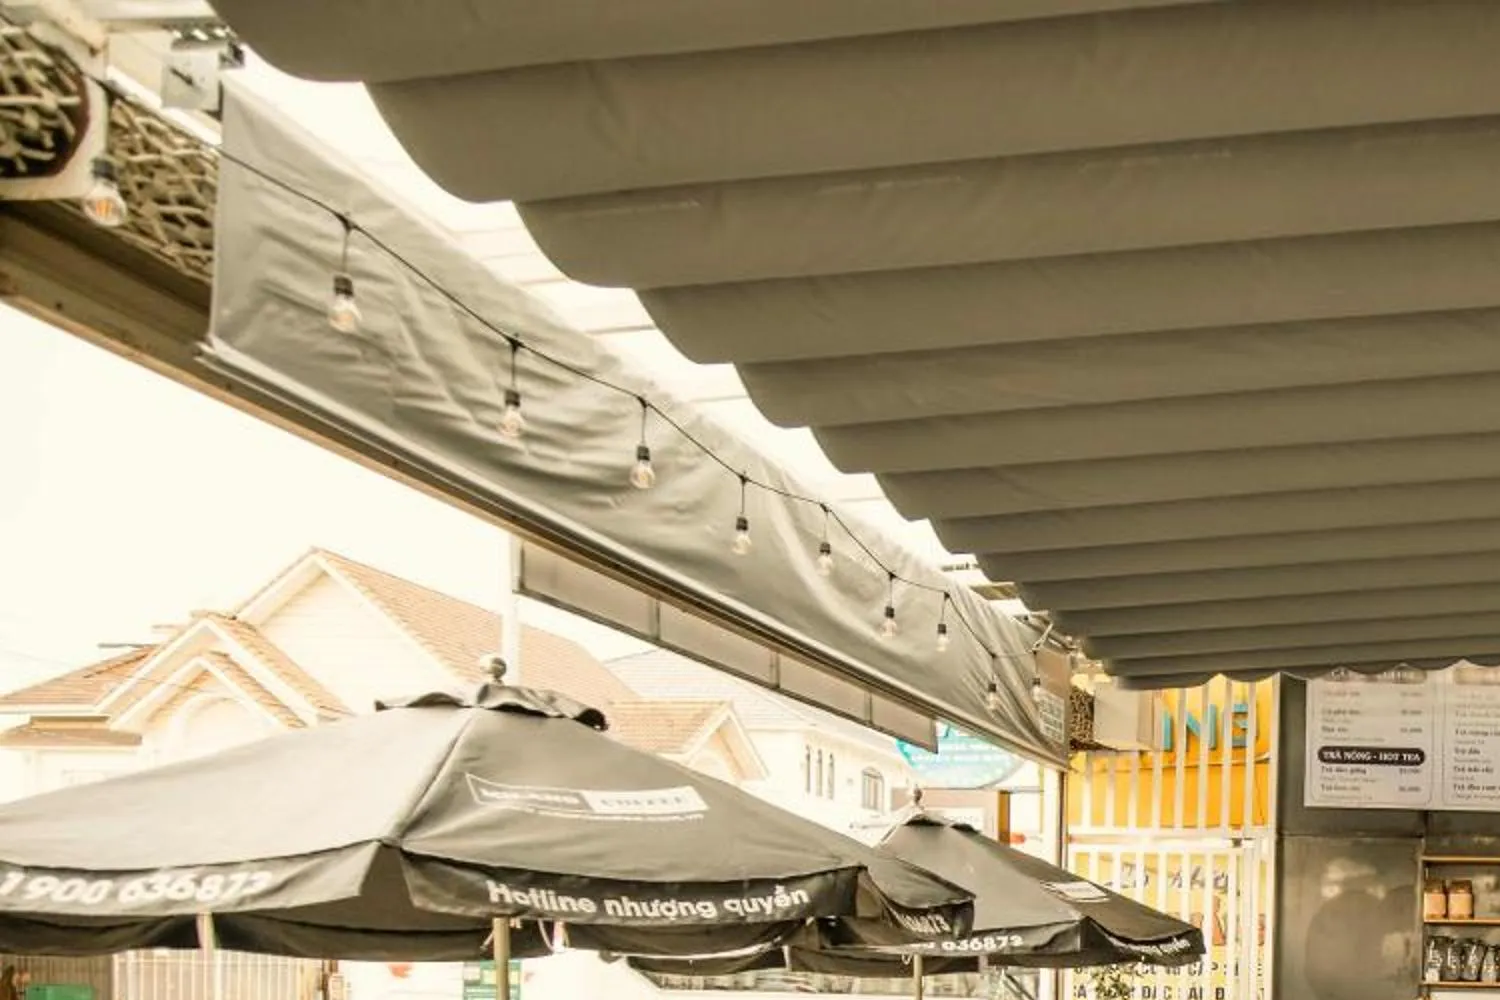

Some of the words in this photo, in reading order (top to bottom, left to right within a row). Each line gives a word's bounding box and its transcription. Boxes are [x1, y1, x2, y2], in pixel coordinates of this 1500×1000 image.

[1379, 751, 1400, 761] HOT
[1402, 753, 1421, 762] TEA
[117, 871, 273, 905] 636873
[487, 880, 598, 913] Hotline
[604, 897, 717, 921] nhượng
